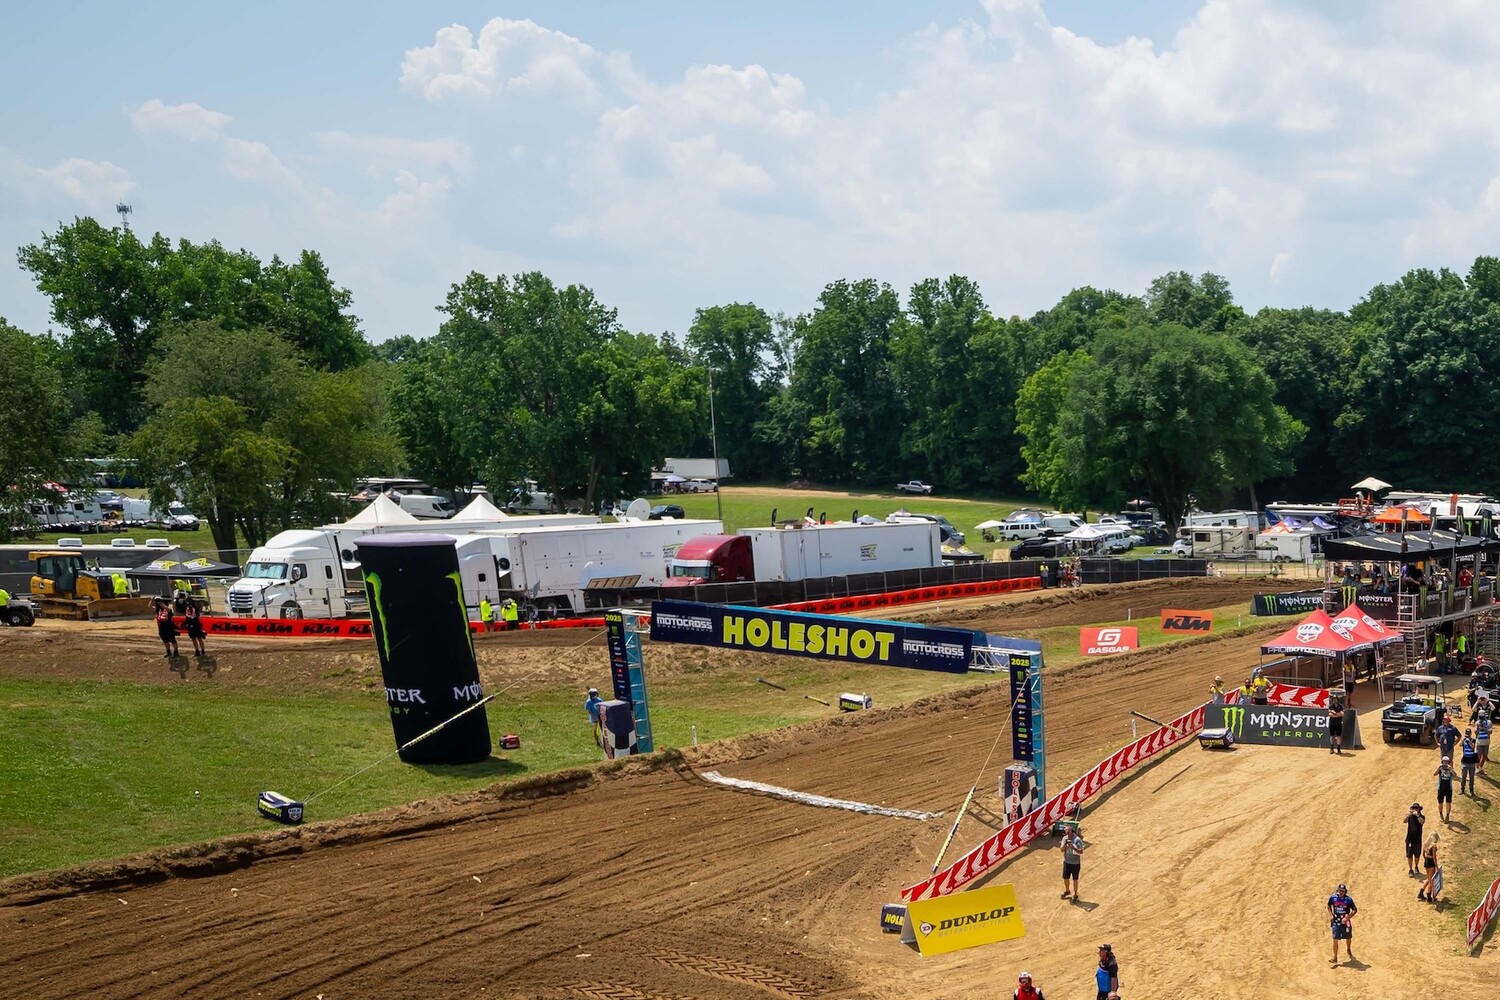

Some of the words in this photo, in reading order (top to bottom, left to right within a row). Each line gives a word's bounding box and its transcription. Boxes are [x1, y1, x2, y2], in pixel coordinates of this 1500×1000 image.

[1279, 596, 1324, 606] MONSTER
[1358, 595, 1394, 603] MONSTER
[605, 614, 622, 622] 2025
[656, 616, 713, 630] MOTOCROSS
[1163, 615, 1212, 631] KTM
[211, 623, 247, 633] KTM
[256, 623, 293, 633] KTM
[302, 623, 341, 634] KTM
[722, 615, 895, 661] HOLESHOT
[903, 642, 964, 657] MOTOCROSS
[1087, 646, 1130, 654] GASGAS
[1011, 658, 1030, 667] 2025
[1262, 731, 1324, 739] ENERGY
[939, 906, 1015, 931] DUNLOP
[938, 922, 988, 937] MOTORCYCLE
